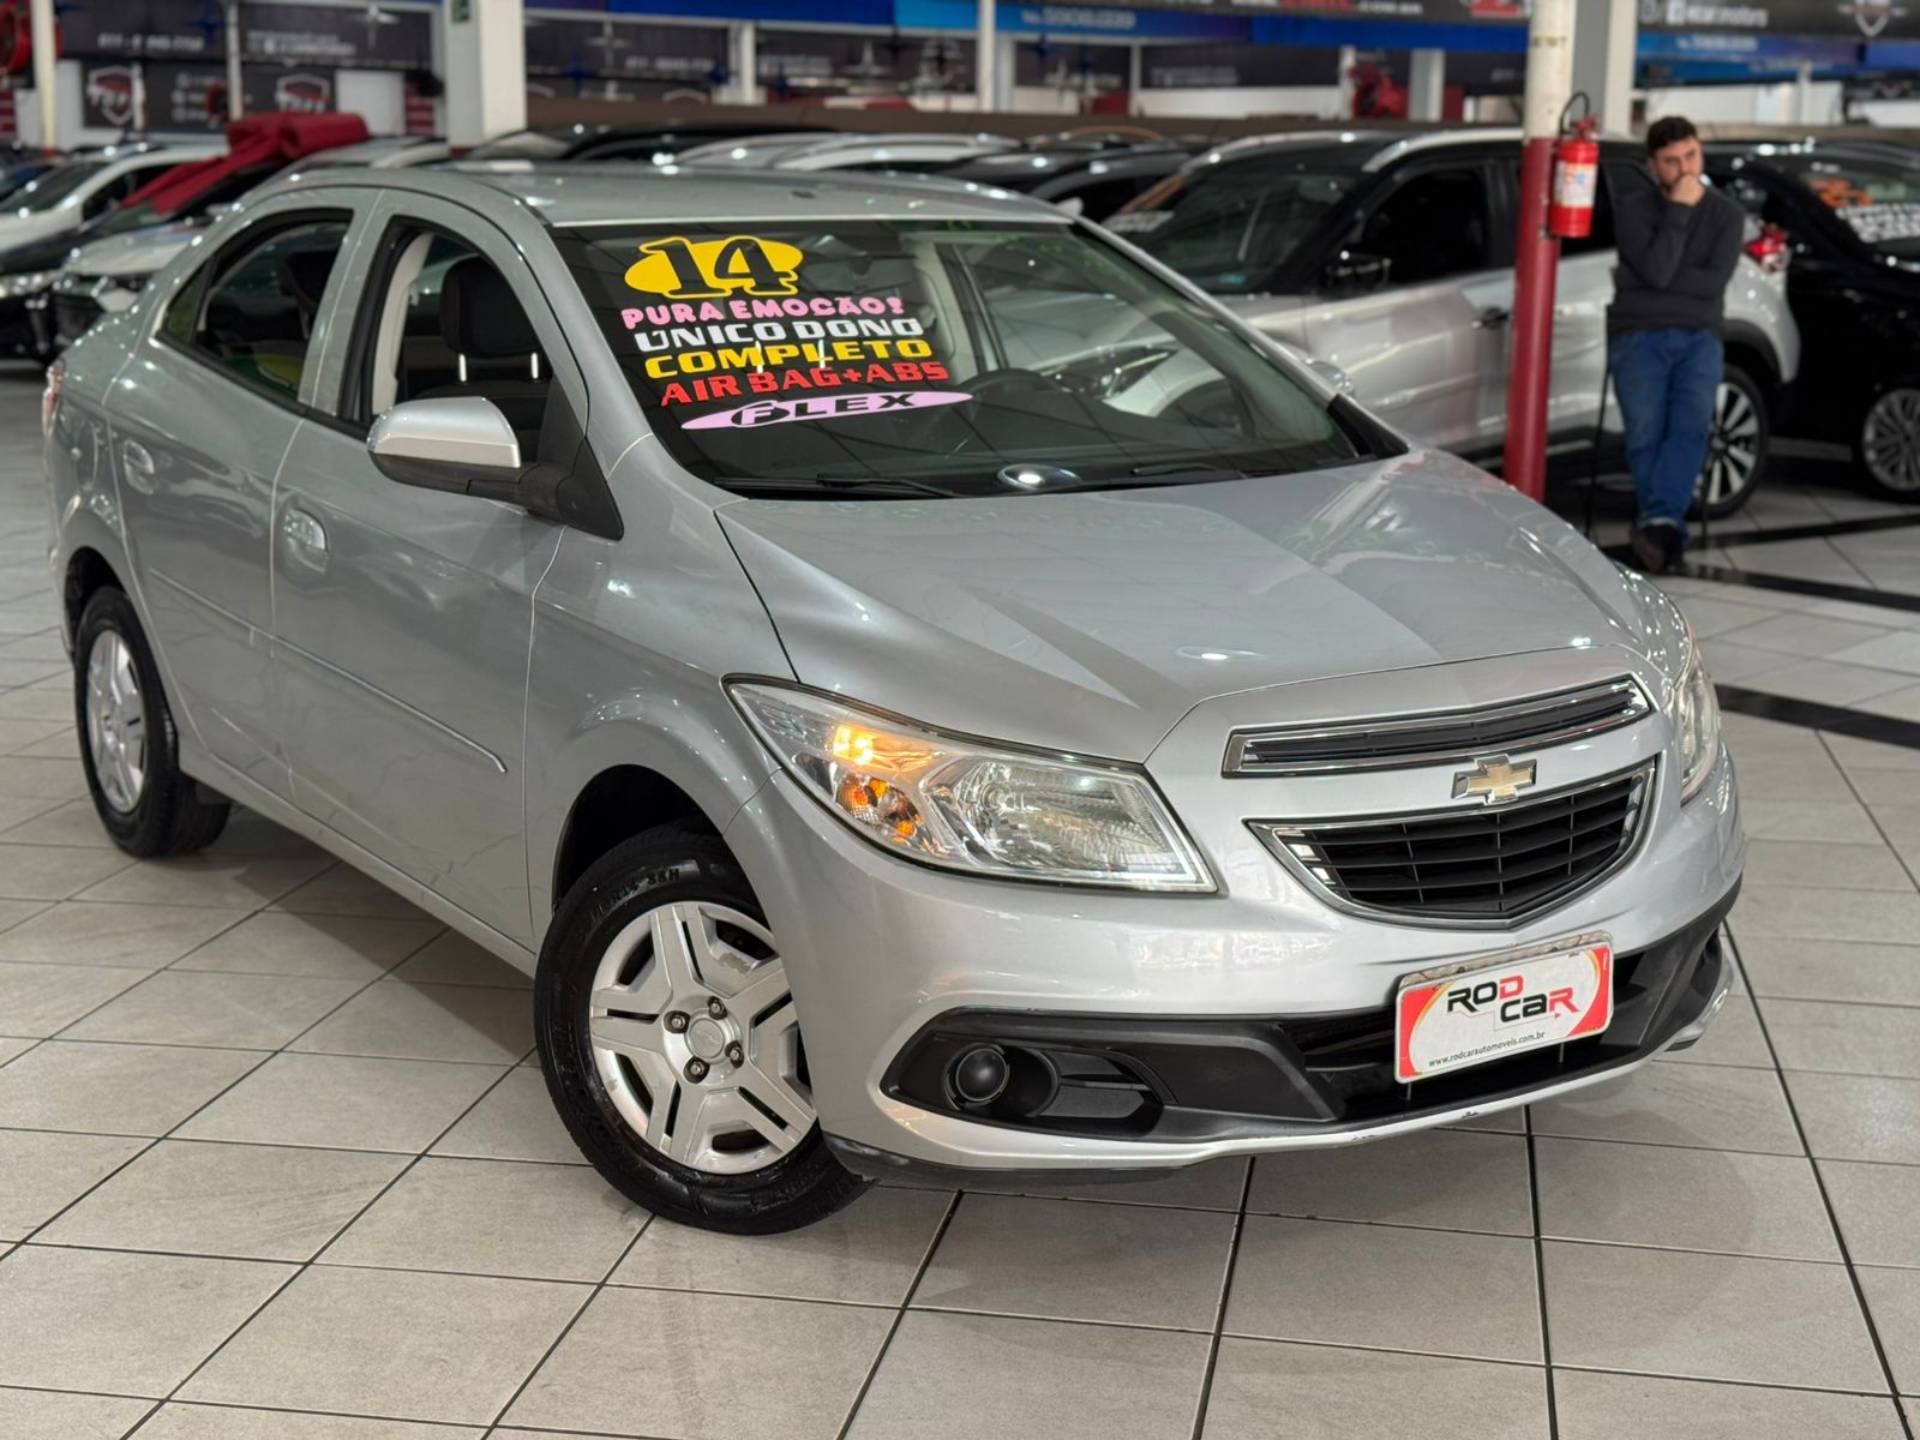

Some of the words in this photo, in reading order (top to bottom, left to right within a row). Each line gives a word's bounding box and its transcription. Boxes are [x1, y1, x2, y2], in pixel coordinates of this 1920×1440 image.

[643, 236, 797, 298] 14
[621, 300, 724, 329] PURA
[792, 317, 924, 341] DONO
[644, 339, 932, 379] COMPLETO
[660, 374, 742, 407] AIR
[749, 360, 949, 394] BAG+ABS
[740, 393, 915, 426] FLEX
[1447, 975, 1524, 1013] ROD
[1429, 1031, 1546, 1067] www.rodcarautomoveis.com.br
